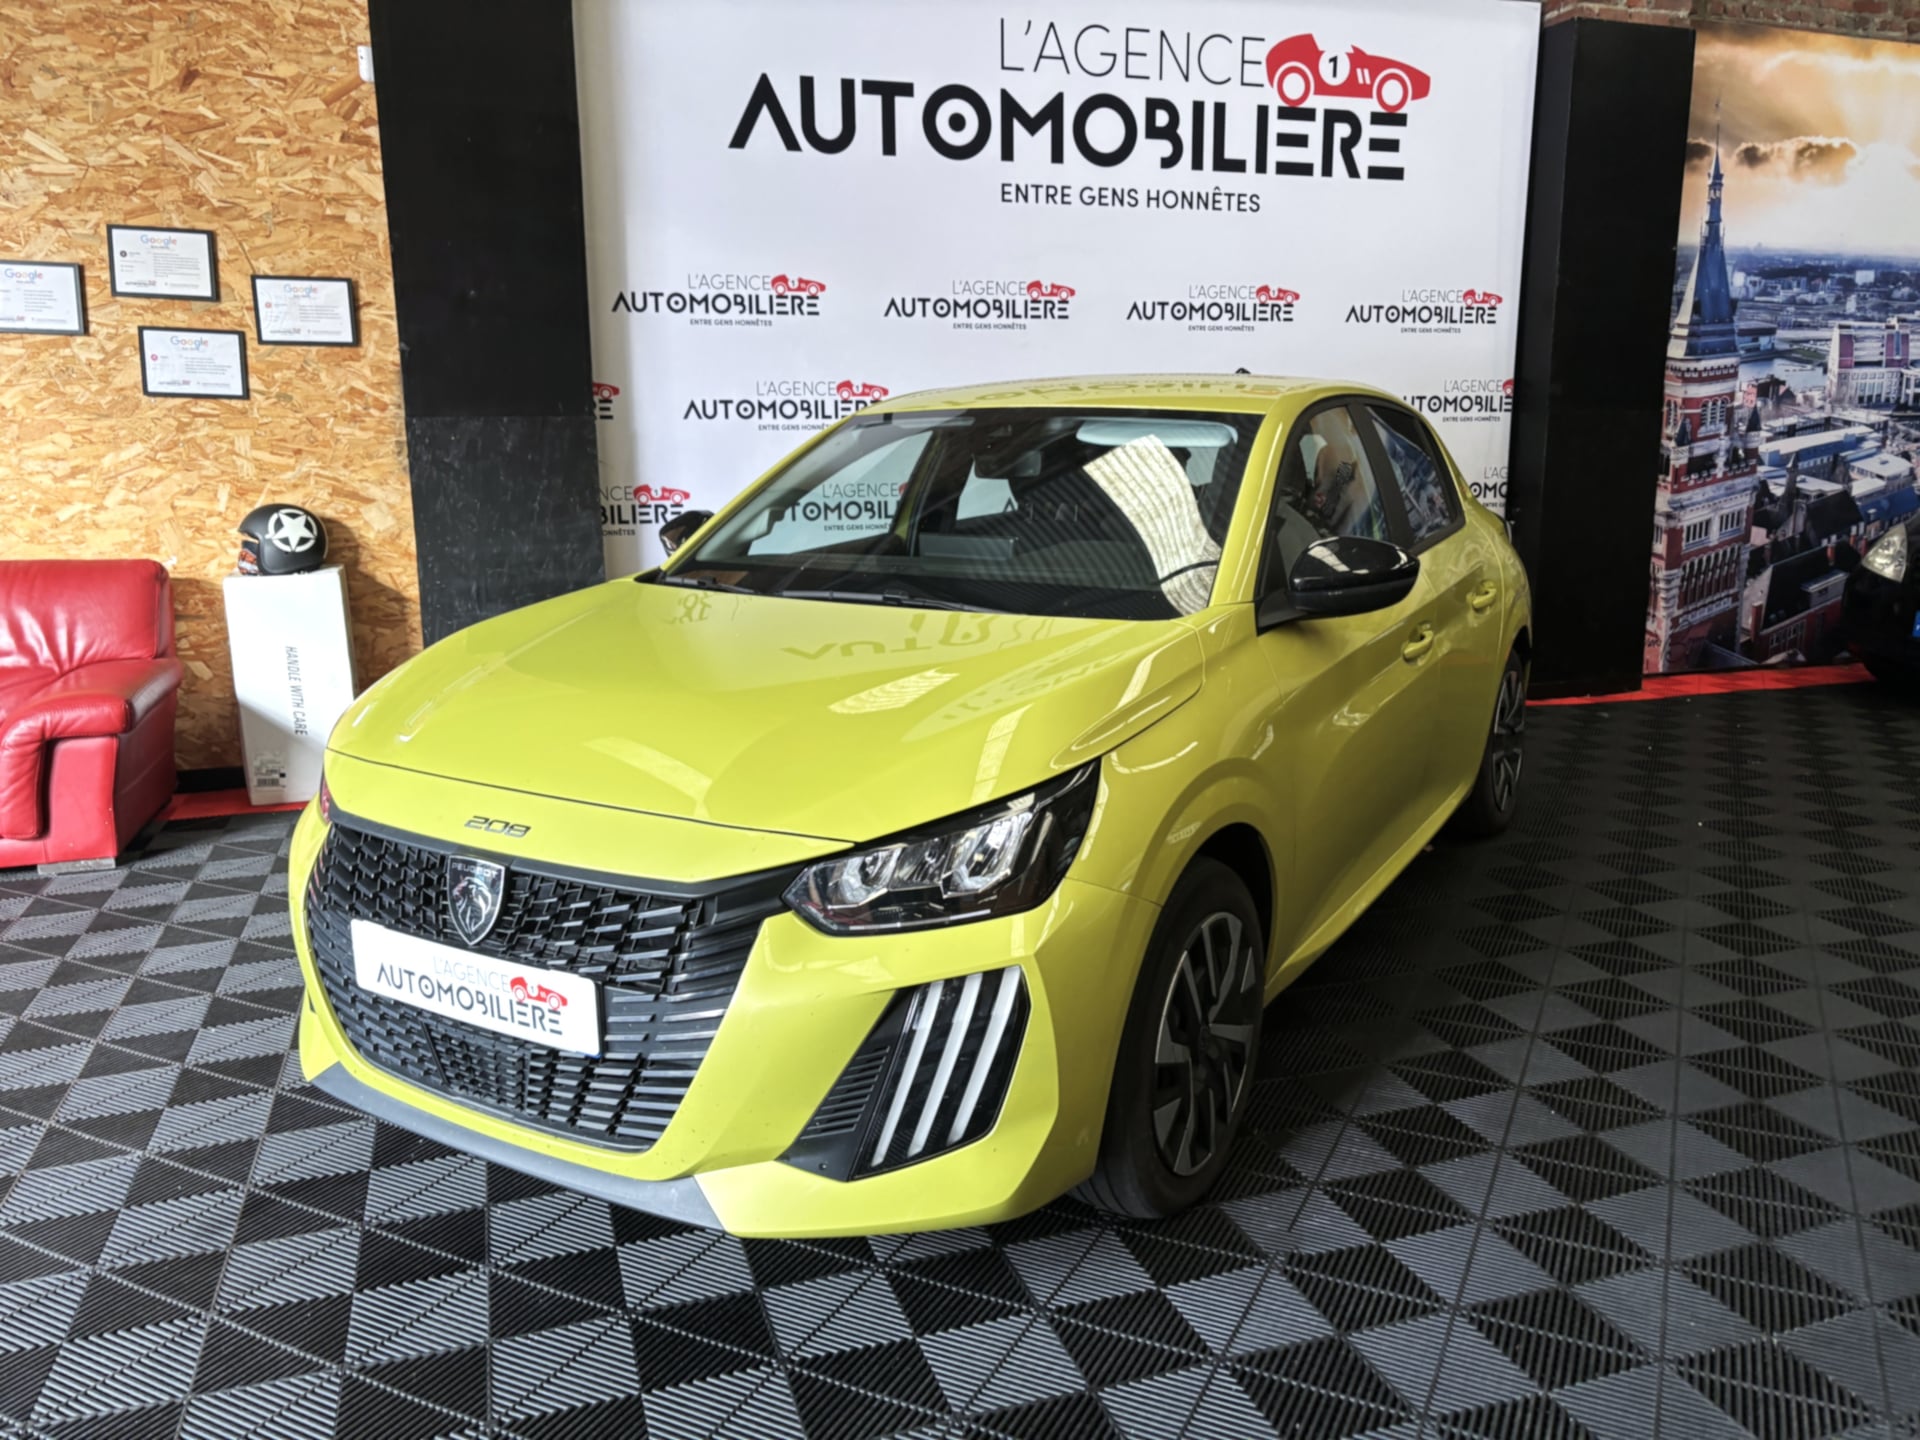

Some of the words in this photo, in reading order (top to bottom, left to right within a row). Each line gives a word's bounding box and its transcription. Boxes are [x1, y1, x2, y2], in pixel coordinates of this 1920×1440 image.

[1000, 18, 1265, 87] L'AGENCE
[1001, 183, 1072, 205] ENTRE
[1079, 186, 1139, 208] GENS
[1146, 186, 1261, 213] HONNÊTES
[139, 234, 177, 248] Google
[4, 268, 43, 282] Google
[688, 274, 771, 291] L'AGENCE
[284, 284, 318, 298] Google
[952, 280, 1026, 297] L'AGENCE
[689, 318, 712, 327] ENTRE
[714, 318, 734, 327] GENS
[953, 322, 973, 330] ENTRE
[974, 322, 992, 330] GENS
[170, 335, 208, 350] Google
[756, 380, 836, 397] L'AGENCE
[758, 423, 780, 431] ENTRE
[285, 645, 302, 682] HANDLE
[290, 684, 304, 708] WITH
[293, 710, 308, 735] CARE
[465, 815, 531, 838] 208
[451, 862, 498, 878] PEUGEOT
[433, 956, 511, 994] L'AGENCE
